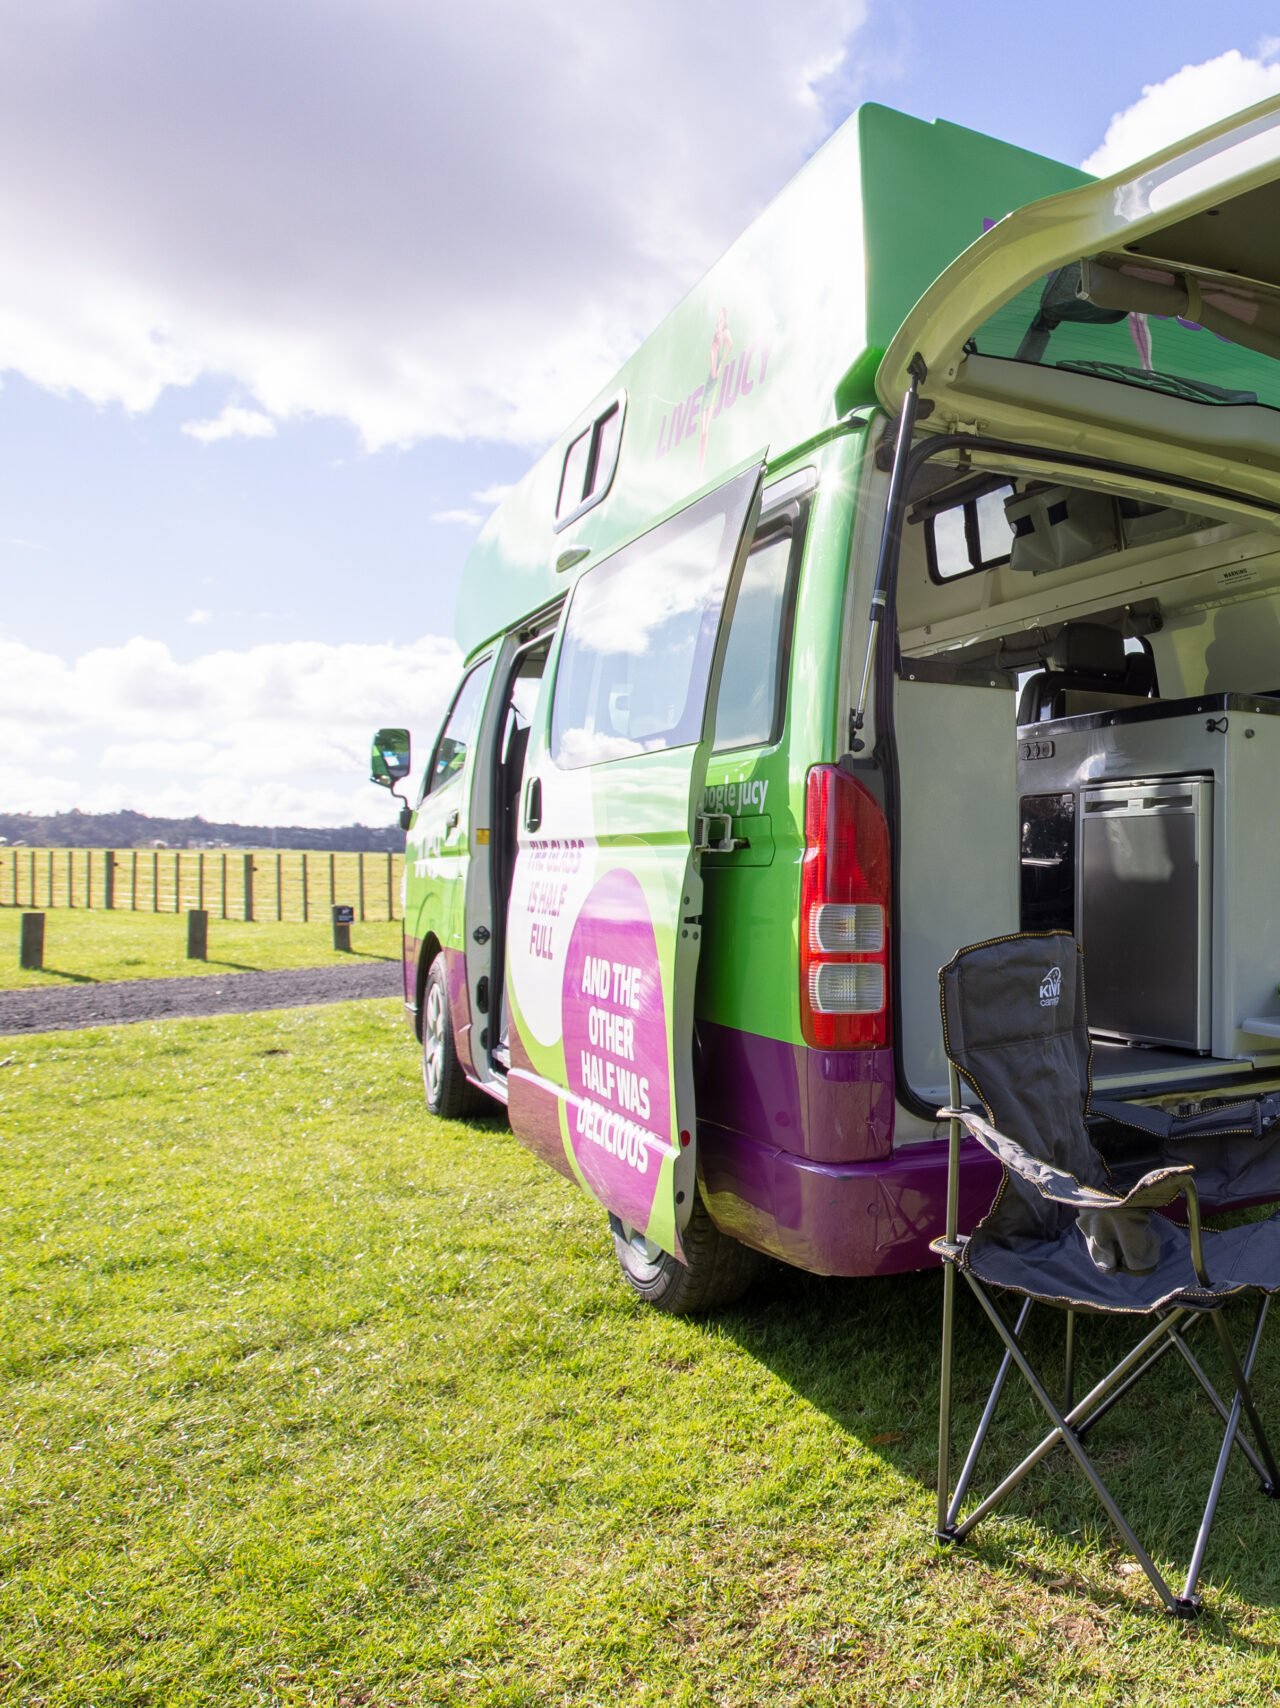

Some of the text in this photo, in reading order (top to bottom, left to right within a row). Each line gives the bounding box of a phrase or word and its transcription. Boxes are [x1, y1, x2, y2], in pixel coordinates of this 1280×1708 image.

[656, 384, 704, 460] LIVE
[736, 773, 768, 816] jucy
[527, 882, 568, 917] IS HALF
[529, 923, 553, 960] FULL
[582, 955, 641, 1010] AND THE
[588, 1006, 634, 1061] OTHER
[581, 1050, 650, 1120] HALF WAS
[576, 1096, 655, 1174] DELICIOUS
